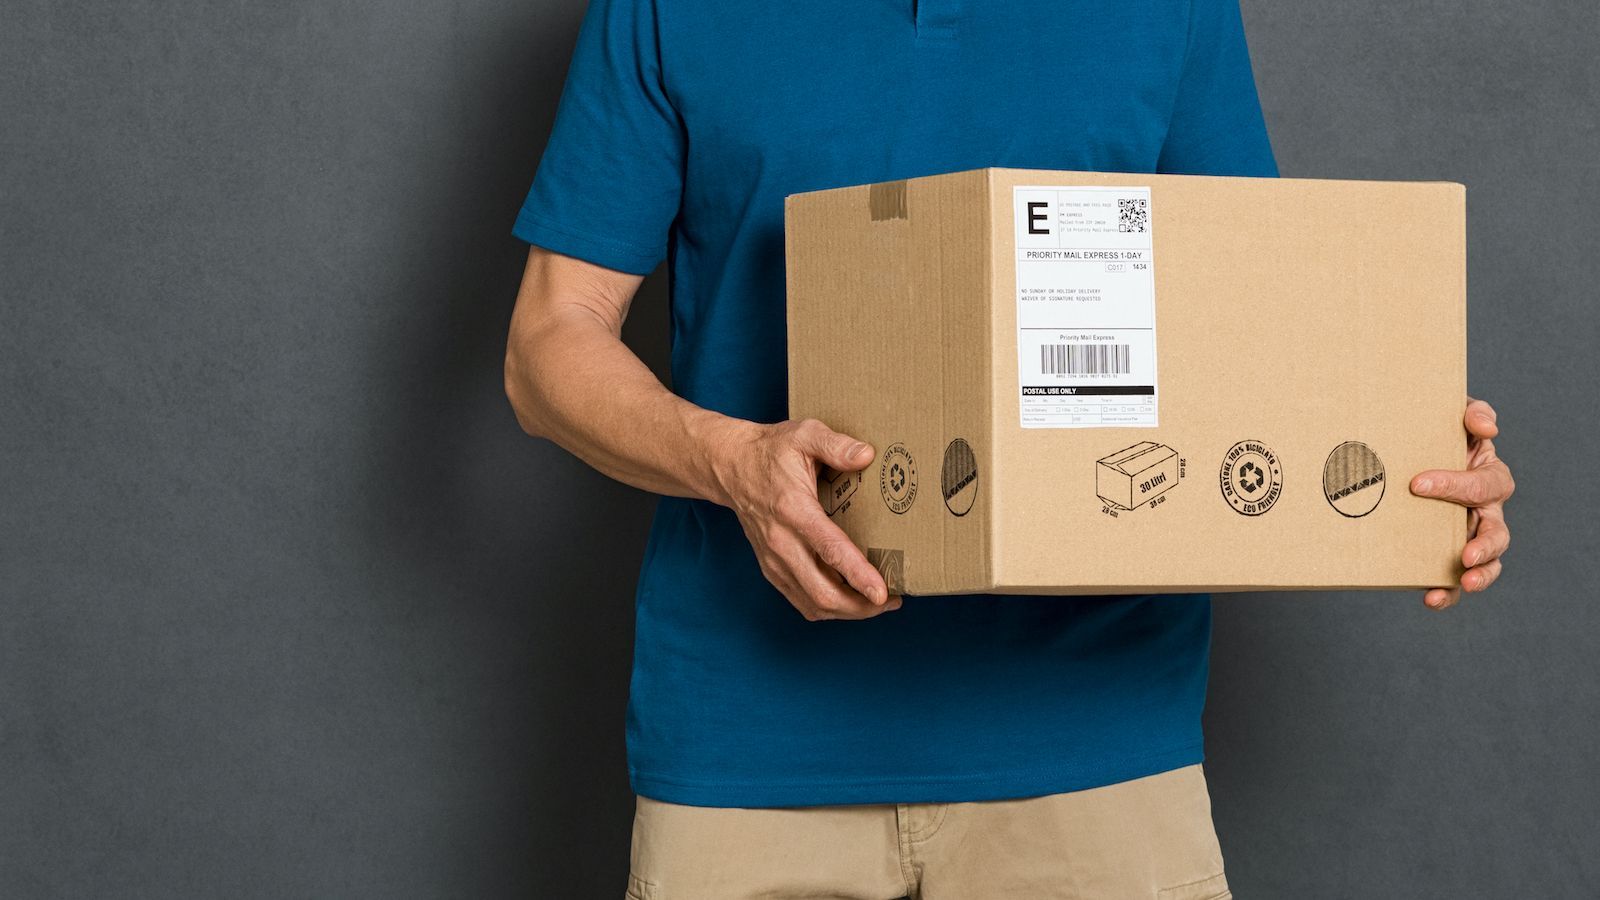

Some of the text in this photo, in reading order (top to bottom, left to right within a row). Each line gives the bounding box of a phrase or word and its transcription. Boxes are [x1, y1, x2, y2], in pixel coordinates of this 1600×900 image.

[1027, 202, 1050, 235] E
[1026, 251, 1142, 259] PRIORITY MAIL EXPRESS 1-DAY
[1228, 446, 1244, 461] 100%
[1180, 458, 1186, 478] 28 cm
[1140, 472, 1167, 493] 30 Litri
[1243, 481, 1279, 512] ECO FRIENDLY
